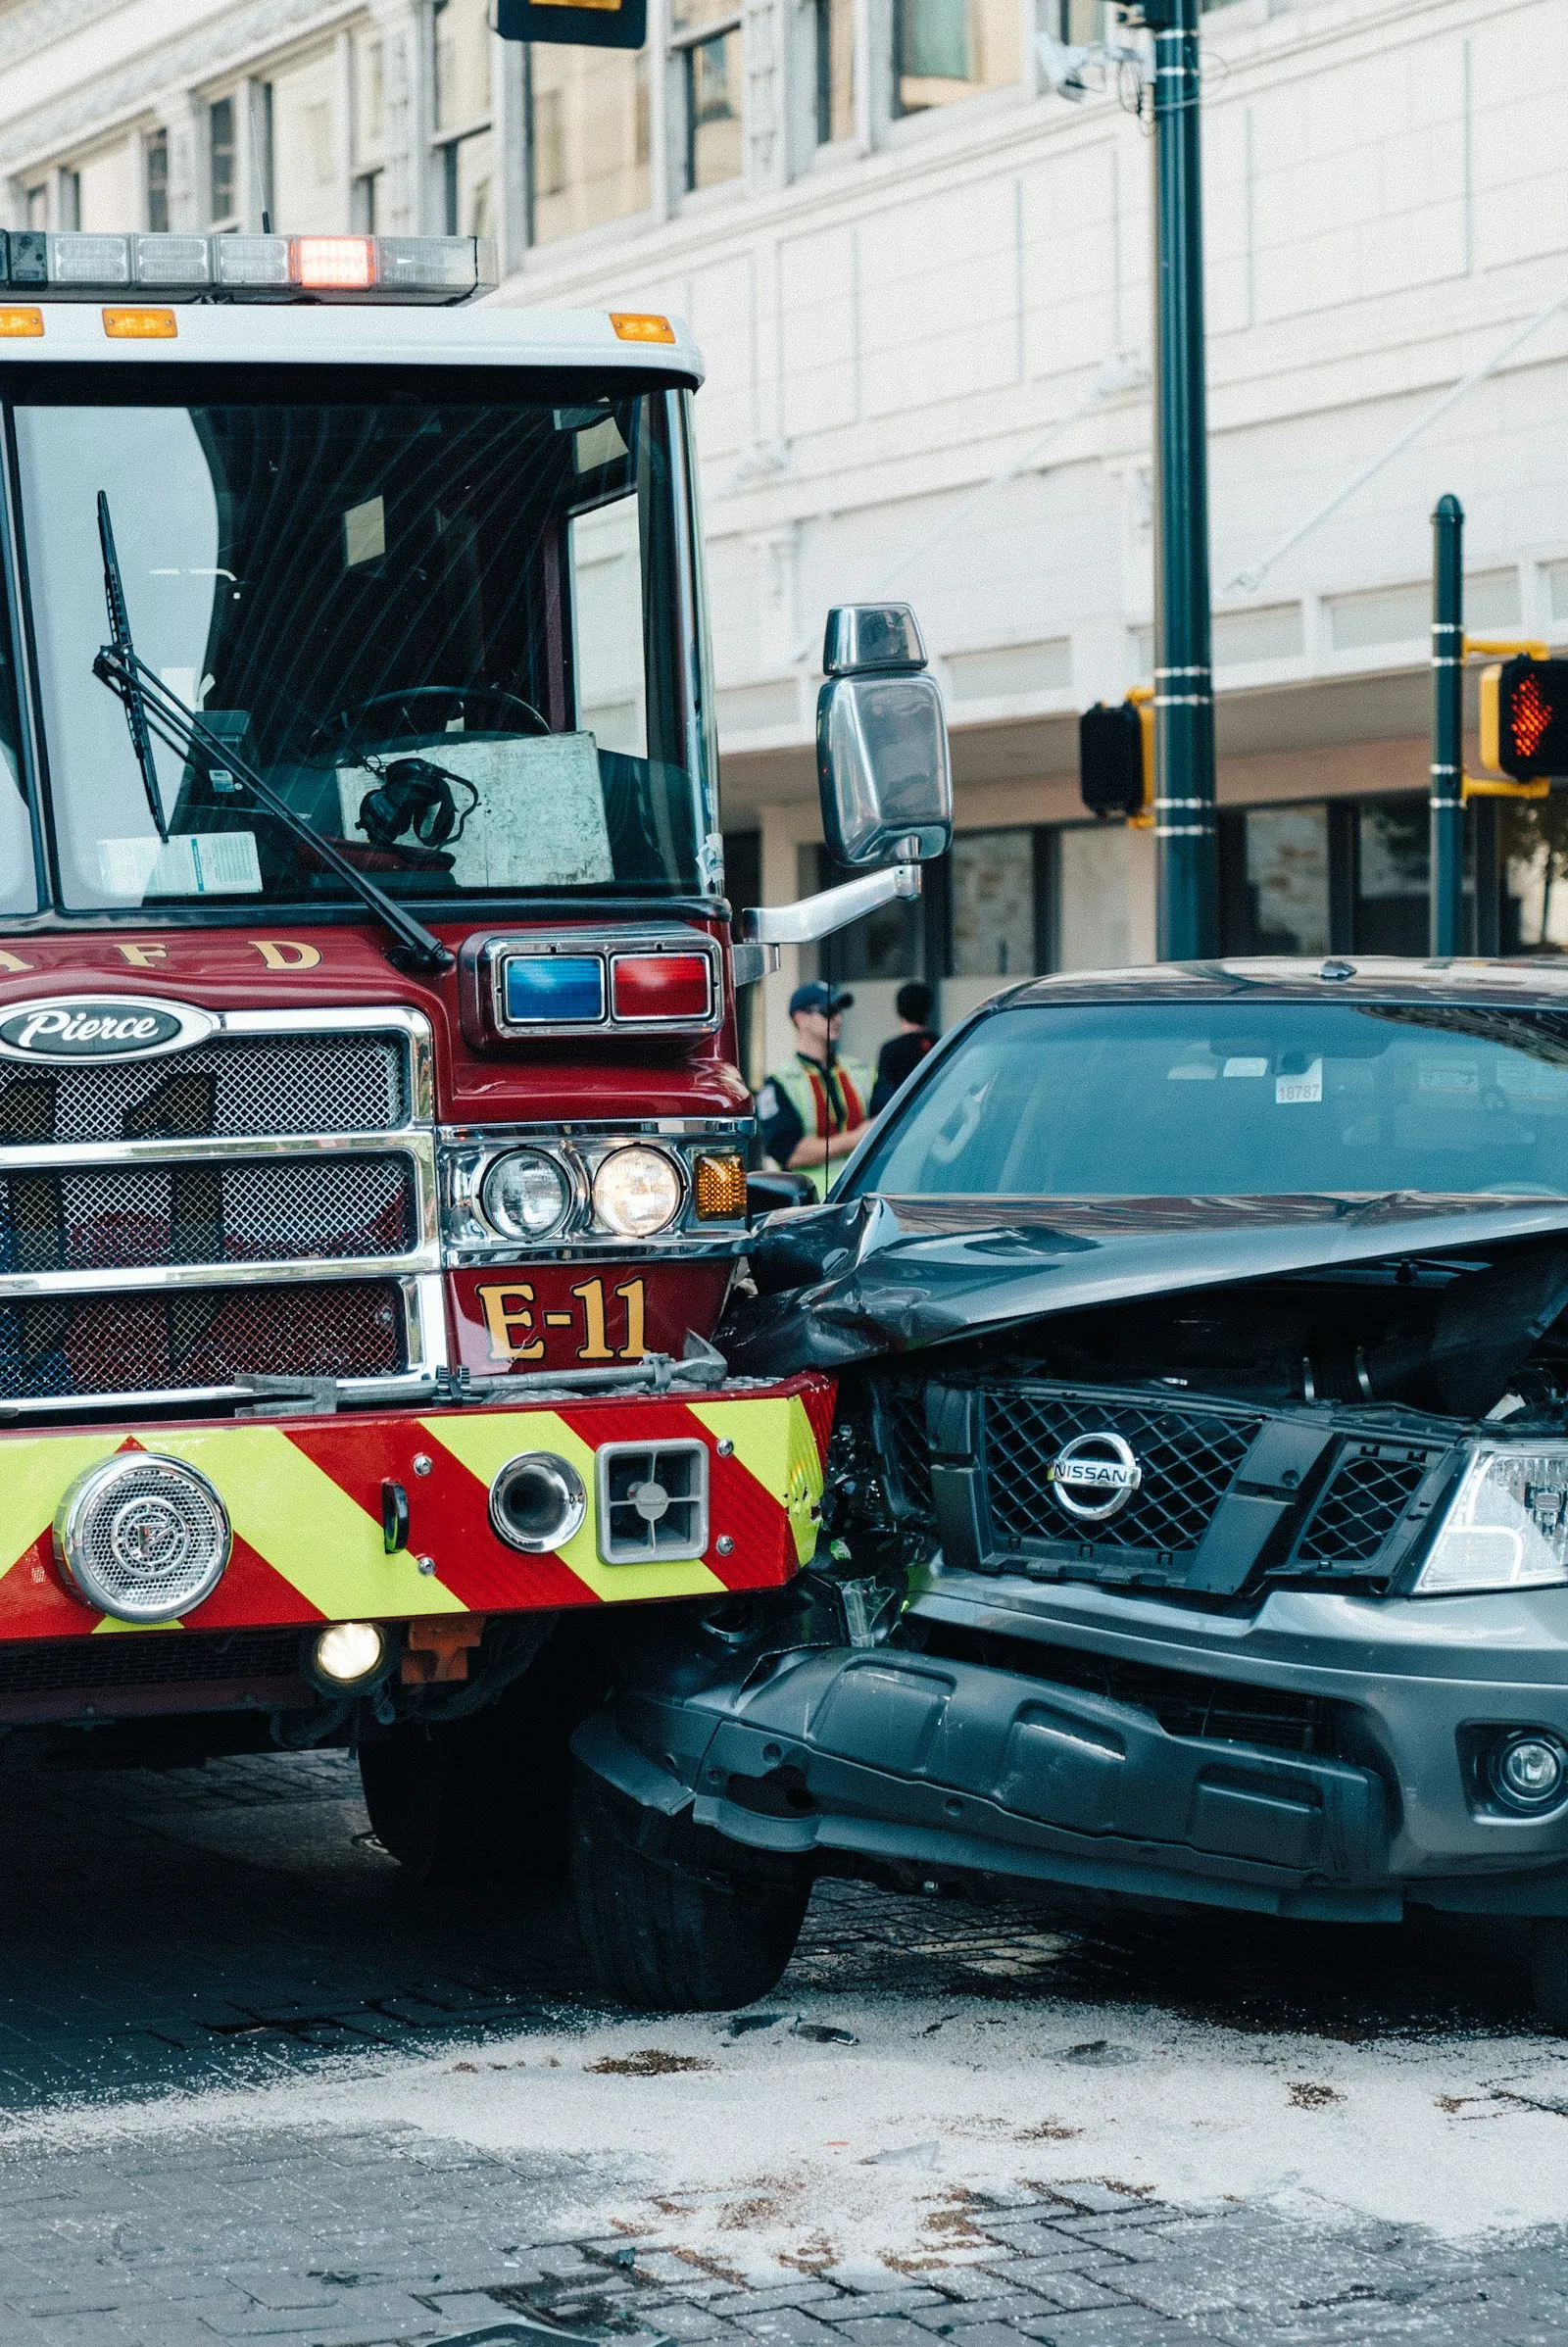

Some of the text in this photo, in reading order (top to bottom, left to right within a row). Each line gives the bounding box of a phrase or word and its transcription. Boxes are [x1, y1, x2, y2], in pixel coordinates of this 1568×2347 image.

[18, 1010, 159, 1049] Pierce
[1279, 1085, 1319, 1100] 18787
[474, 1276, 652, 1360] E-11
[1054, 1464, 1127, 1483] NISSAN
